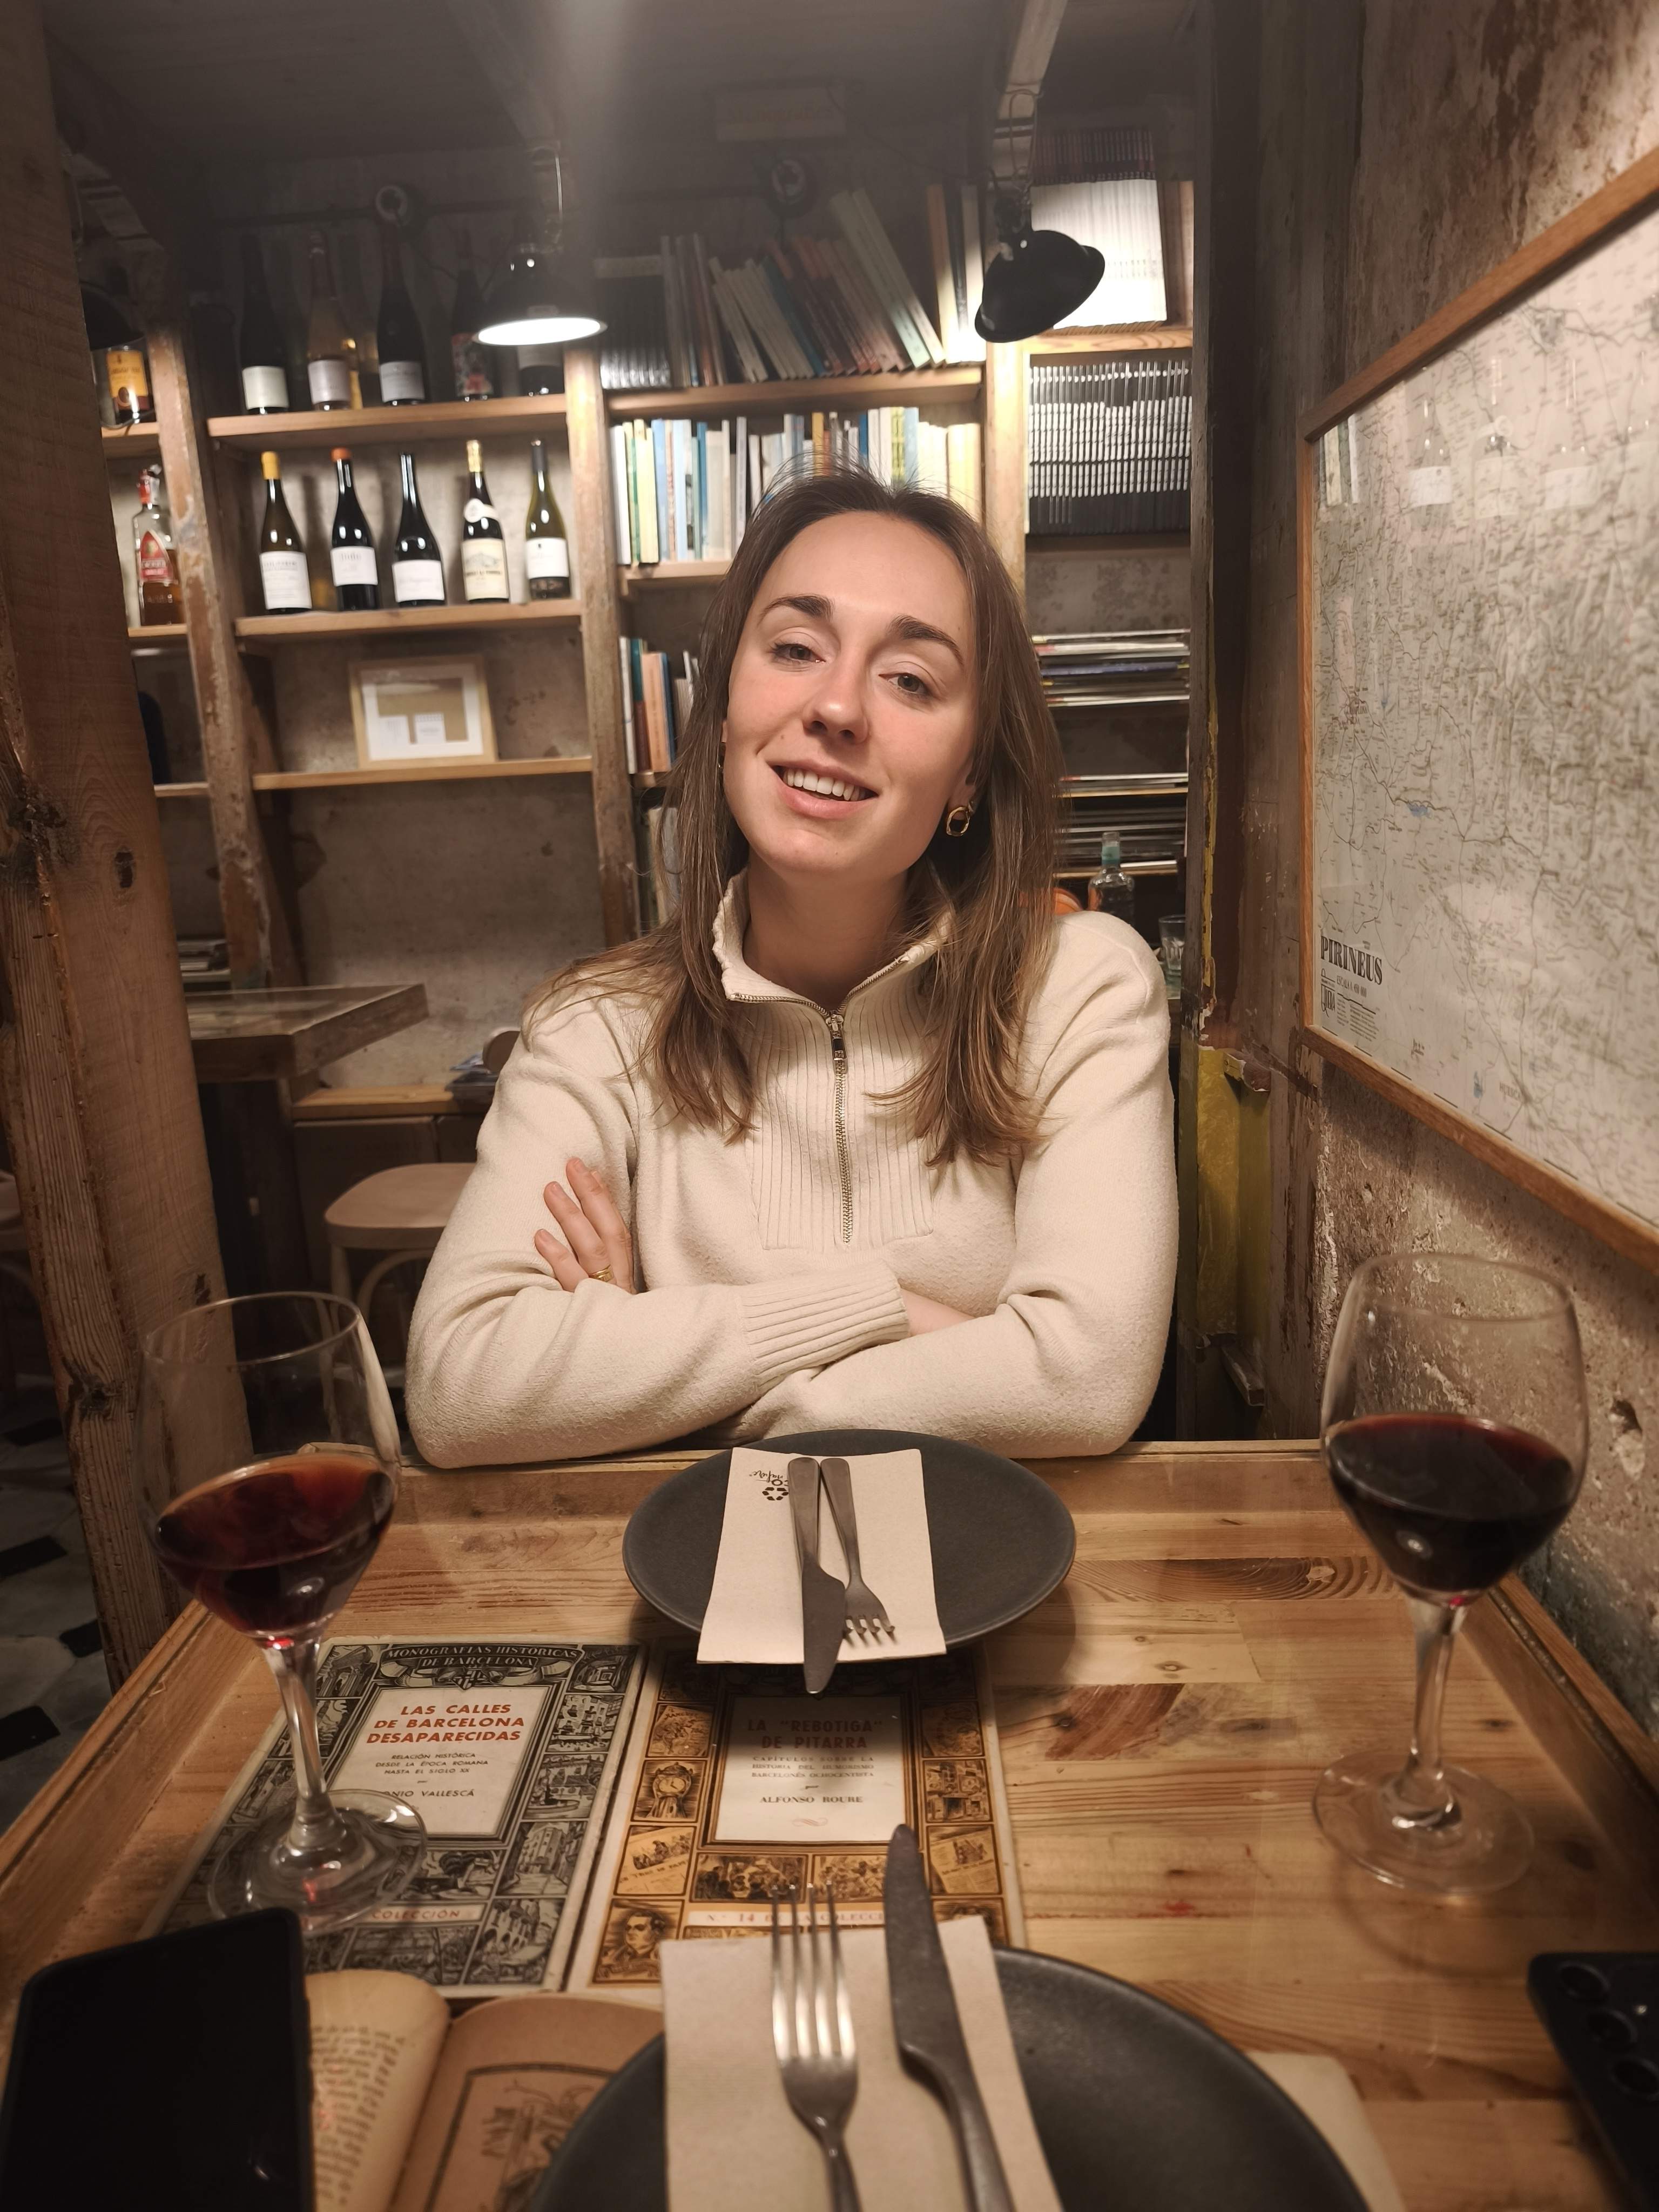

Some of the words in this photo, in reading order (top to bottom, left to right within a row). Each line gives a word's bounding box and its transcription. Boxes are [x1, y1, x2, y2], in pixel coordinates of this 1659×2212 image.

[1321, 936, 1382, 985] PIRINEUS
[388, 1645, 491, 1658] MONOGRAFIAS
[444, 1656, 533, 1666] BARCELONA
[401, 1705, 436, 1715] LAS
[446, 1704, 511, 1714] CALLES
[374, 1719, 399, 1729] DE
[406, 1717, 524, 1728] BARCELONA
[747, 1719, 767, 1731] LA
[367, 1731, 521, 1744] DESAPARECIDAS
[761, 1736, 783, 1749] DE
[794, 1736, 868, 1749] PITARRA
[422, 1789, 475, 1797] VALLESCÁ
